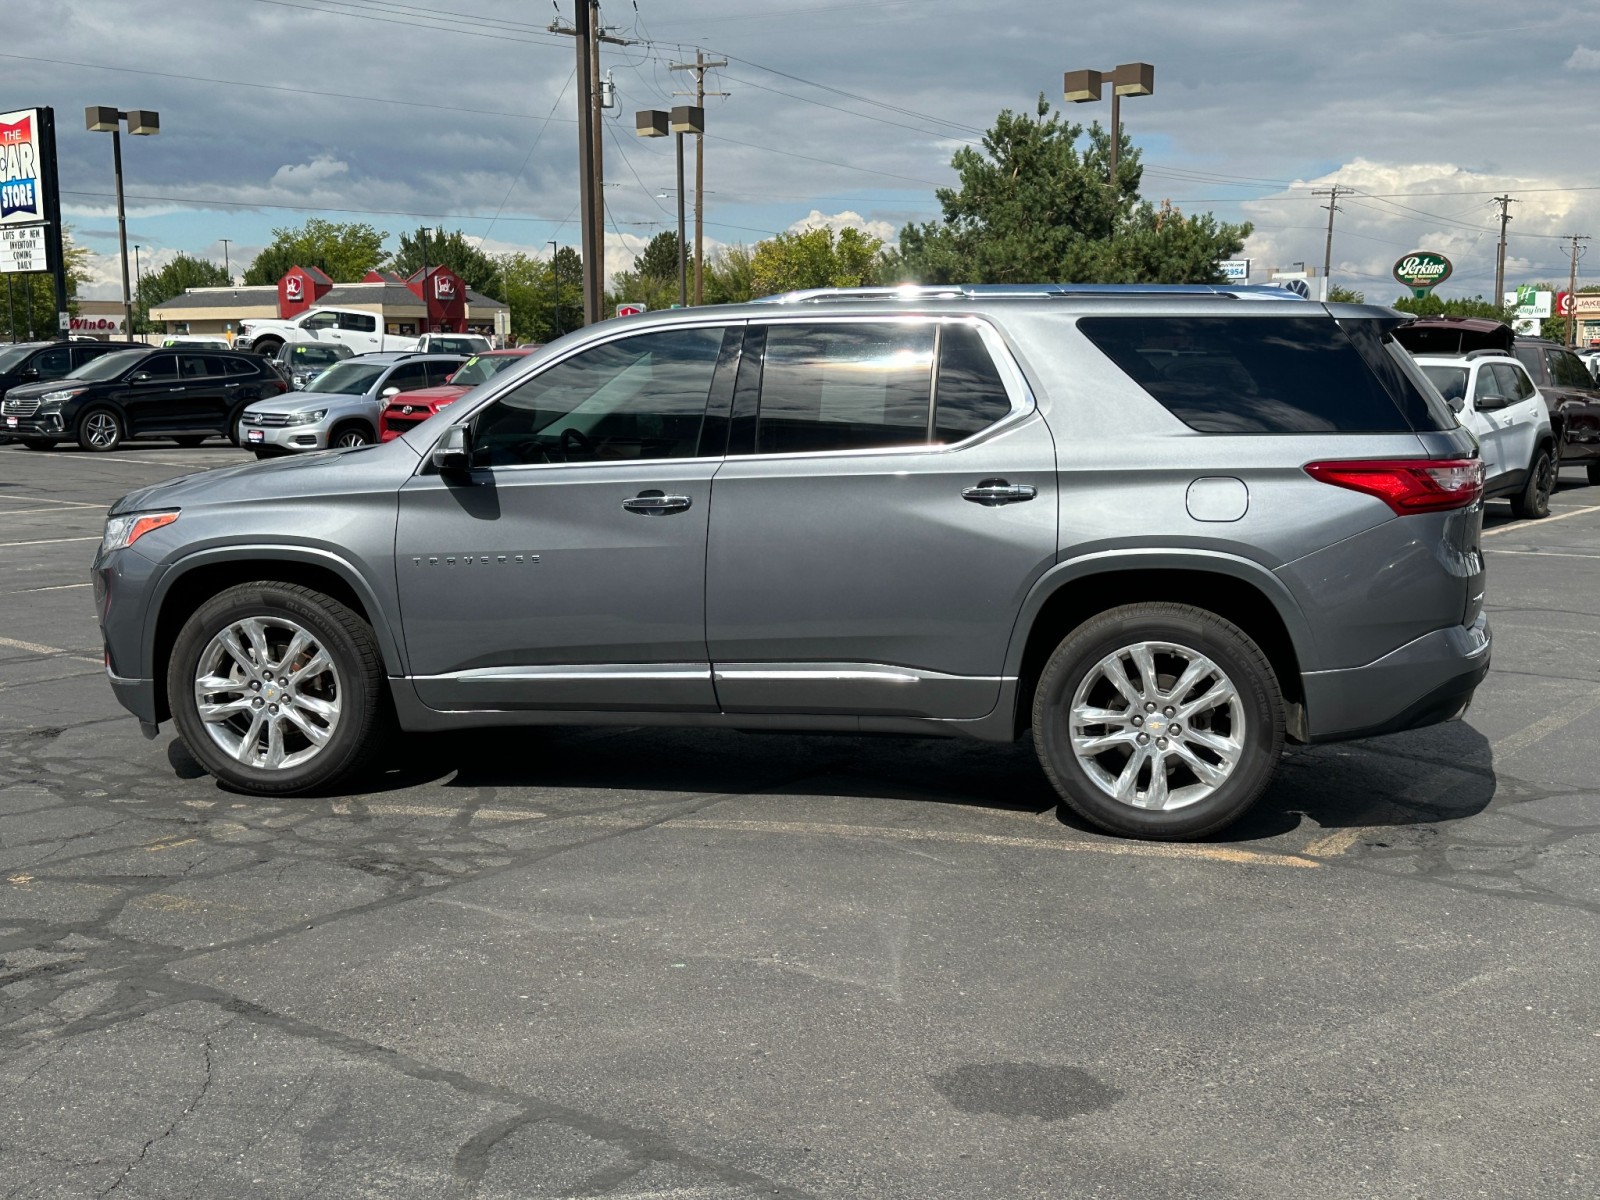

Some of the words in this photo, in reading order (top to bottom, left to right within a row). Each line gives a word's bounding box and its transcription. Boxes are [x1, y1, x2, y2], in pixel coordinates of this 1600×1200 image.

[3, 129, 22, 141] THE
[2, 183, 33, 208] STORE
[2, 231, 15, 240] LOTS
[19, 230, 26, 239] OF
[10, 239, 36, 250] INVENTORY
[1398, 257, 1445, 275] Perkins
[70, 318, 115, 330] WinCo
[412, 554, 540, 567] TRAVERSE
[286, 601, 347, 653] BLACKHAWK
